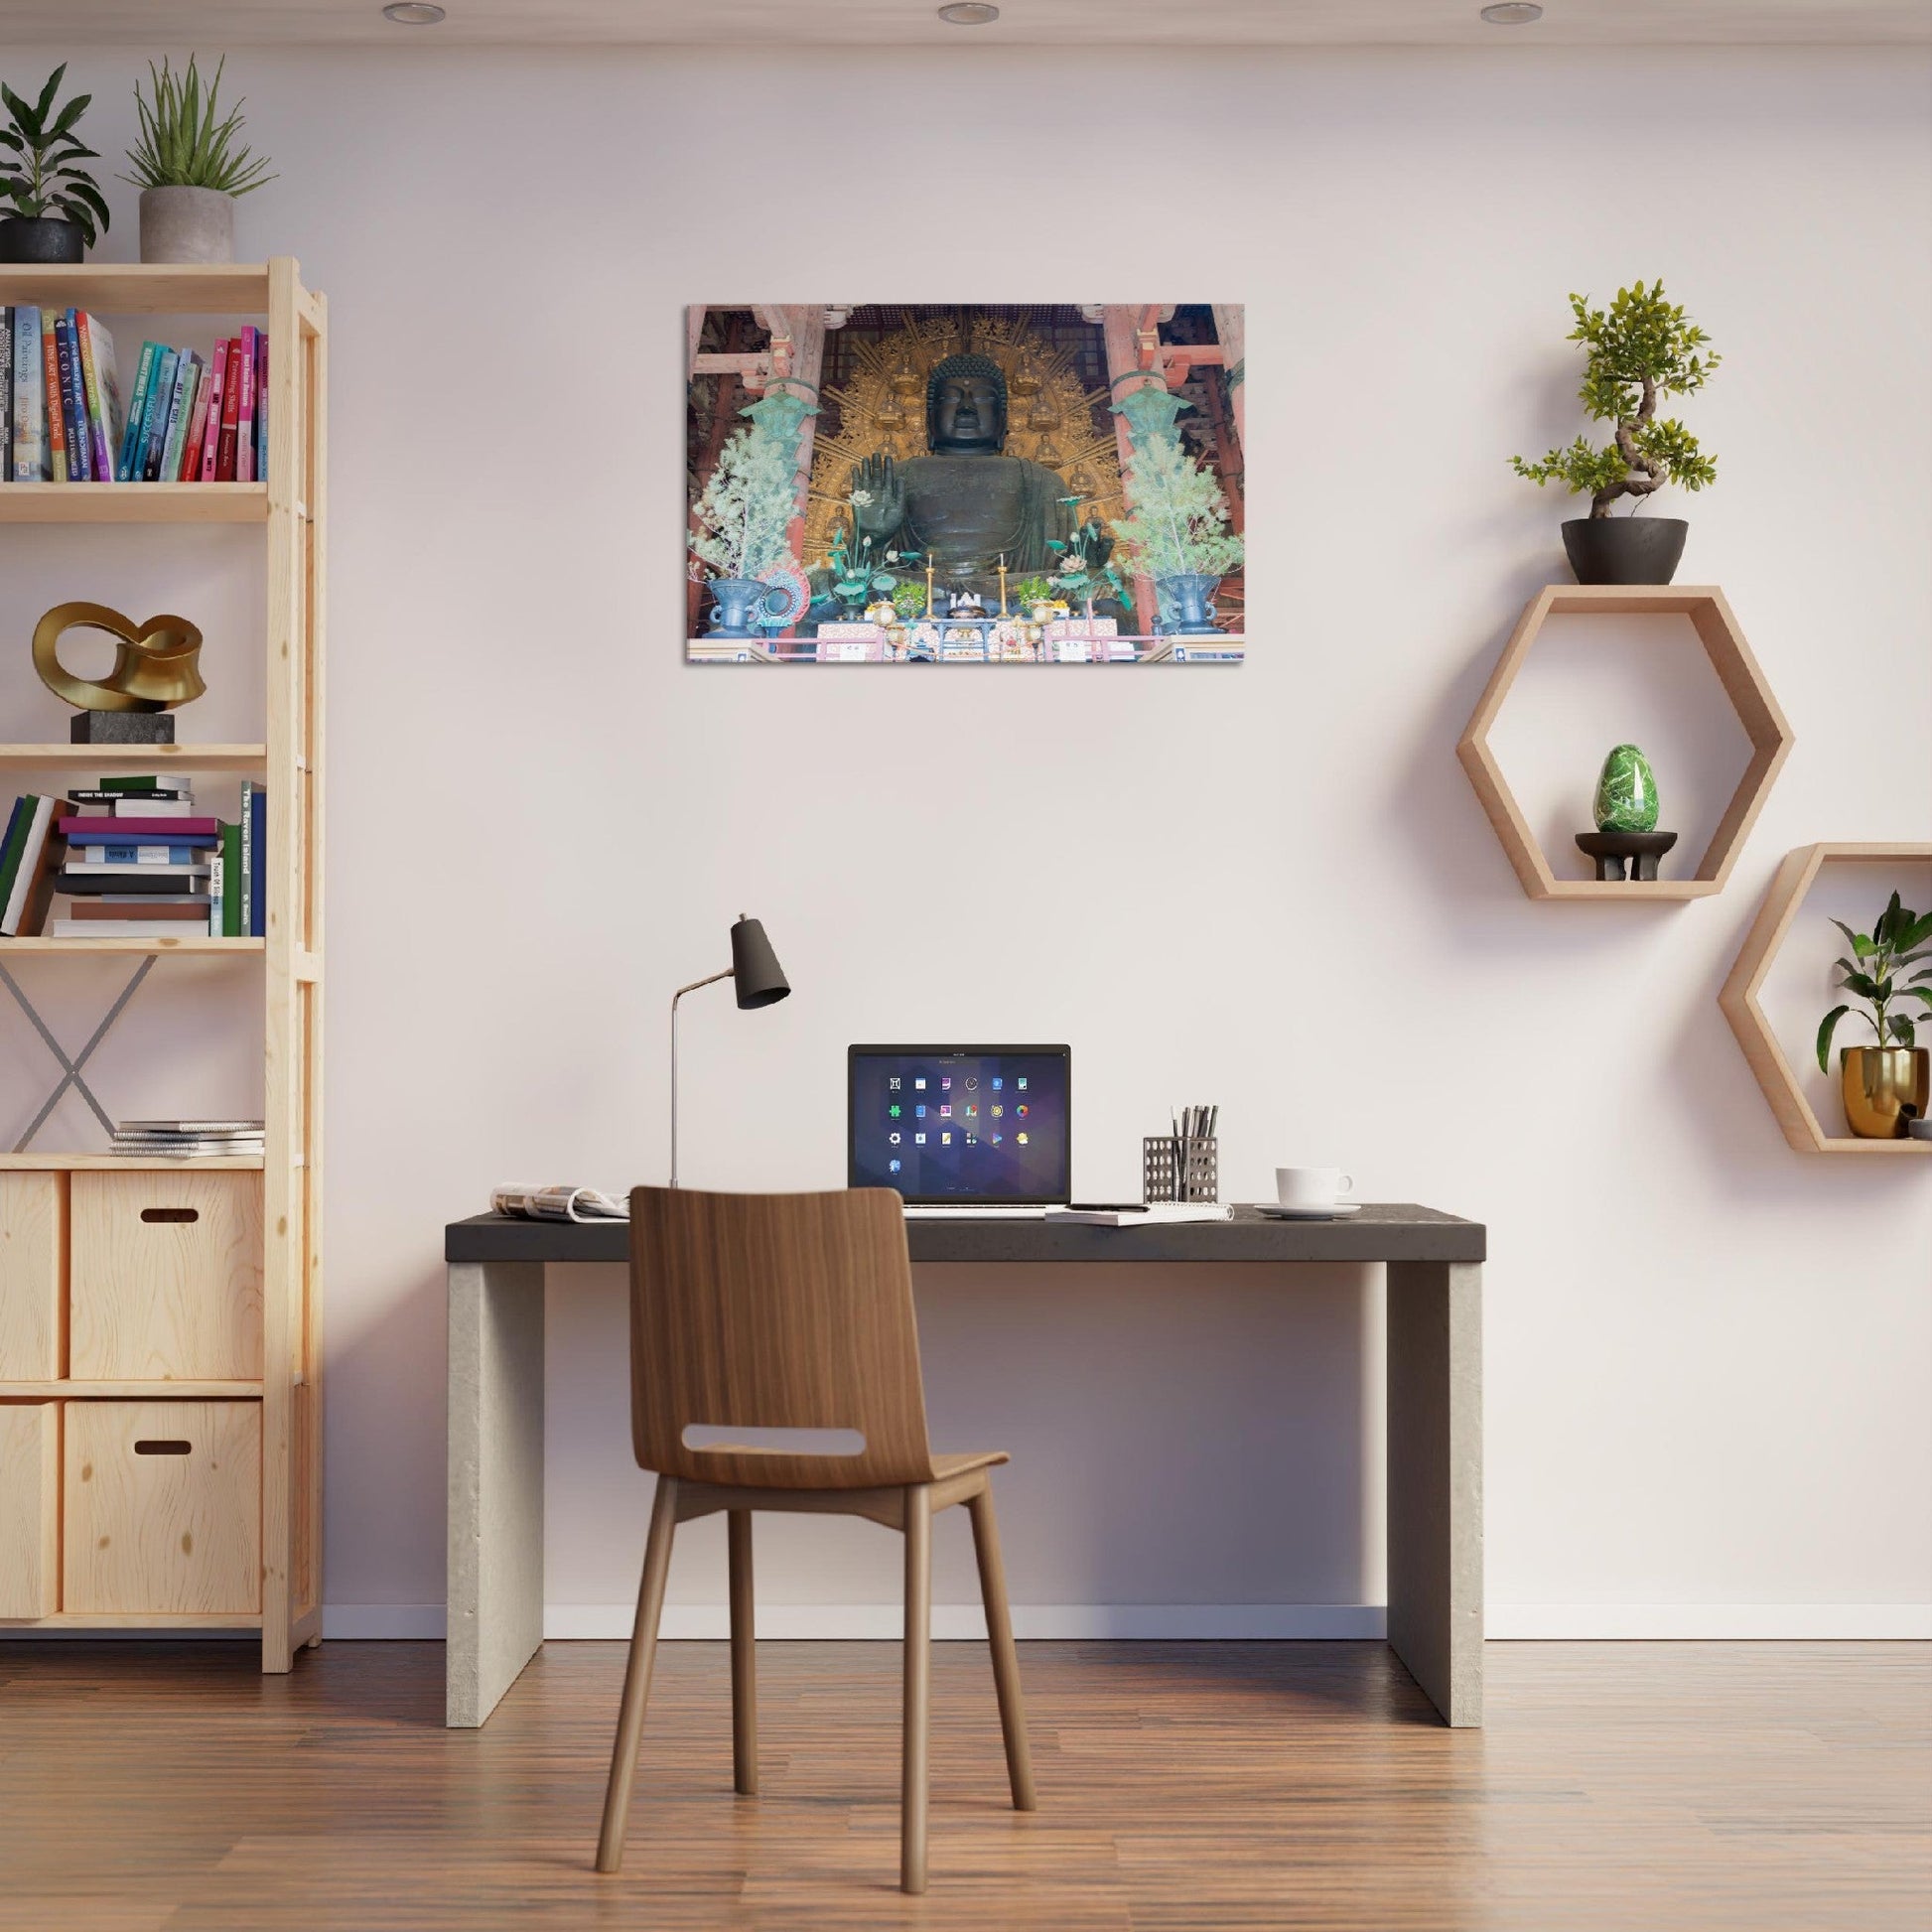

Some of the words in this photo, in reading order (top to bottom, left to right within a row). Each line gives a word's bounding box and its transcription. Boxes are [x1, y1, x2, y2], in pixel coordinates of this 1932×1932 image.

[22, 323, 32, 337] Oil
[78, 325, 94, 371] Watercolor
[59, 342, 73, 405] ICONIC
[85, 372, 97, 408] Portraits
[228, 360, 239, 392] Parenting
[227, 393, 236, 412] Skills
